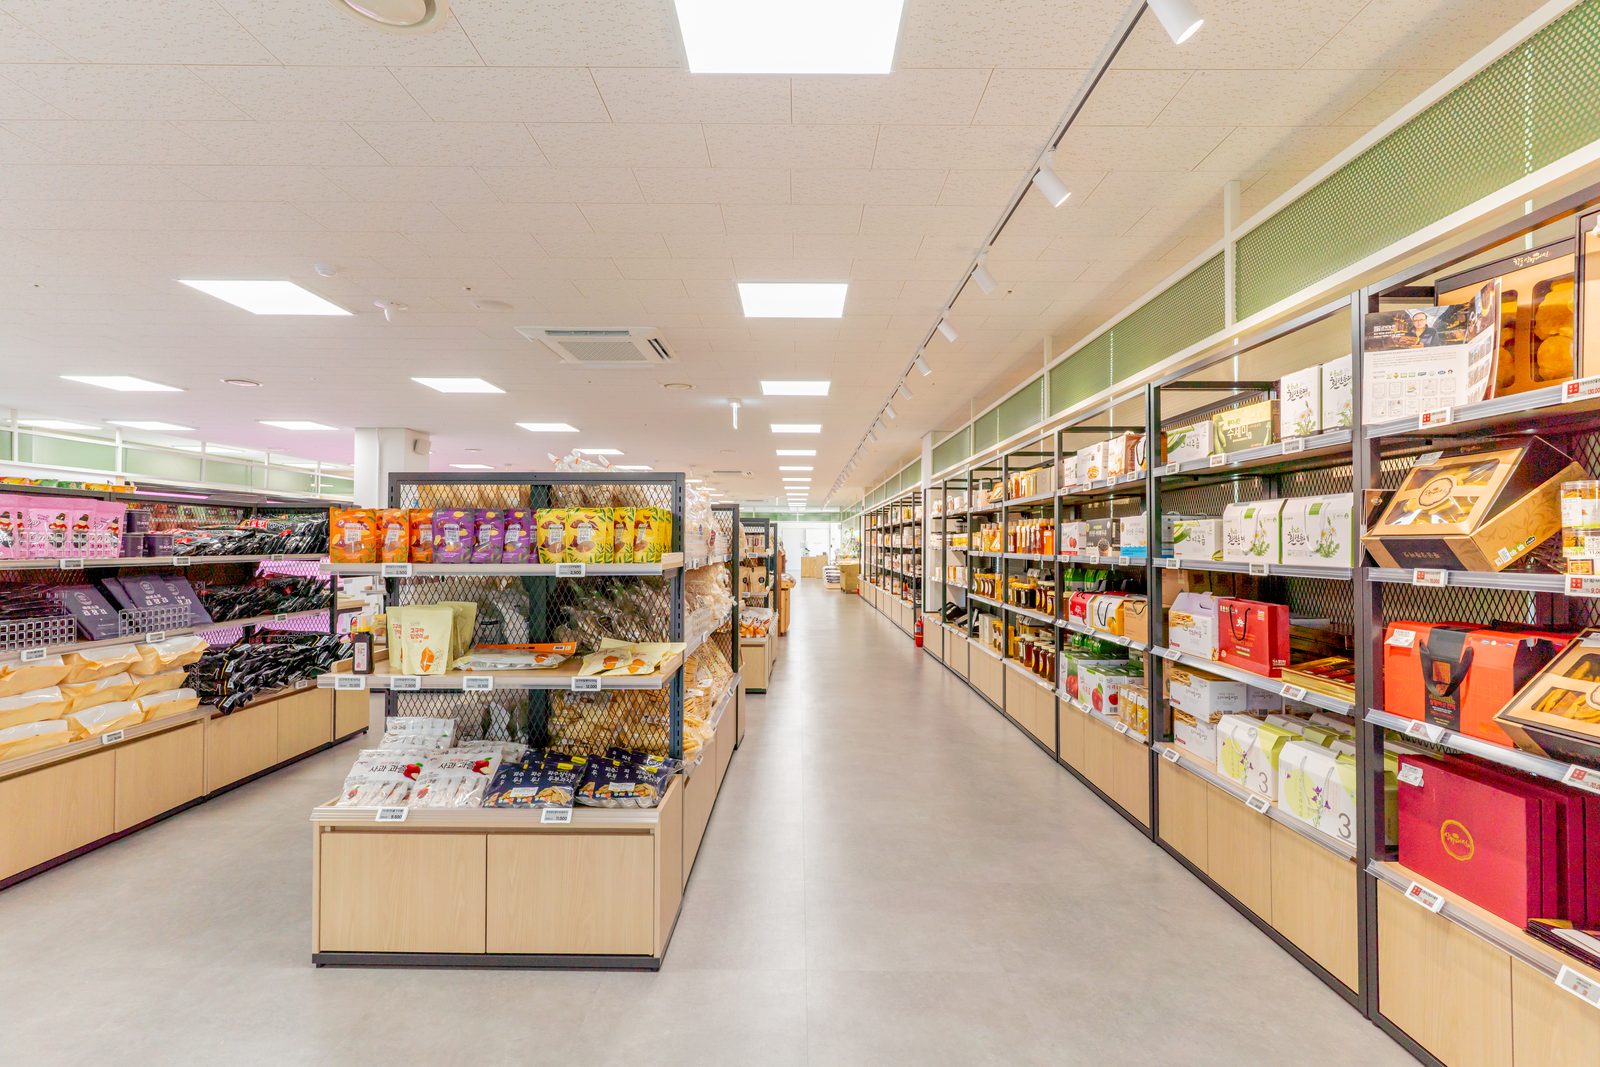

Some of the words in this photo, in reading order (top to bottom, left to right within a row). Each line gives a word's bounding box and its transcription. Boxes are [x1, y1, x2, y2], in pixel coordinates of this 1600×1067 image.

[369, 764, 388, 773] 사과
[439, 762, 458, 770] 사과
[1258, 771, 1269, 794] 3
[1337, 812, 1352, 840] 3
